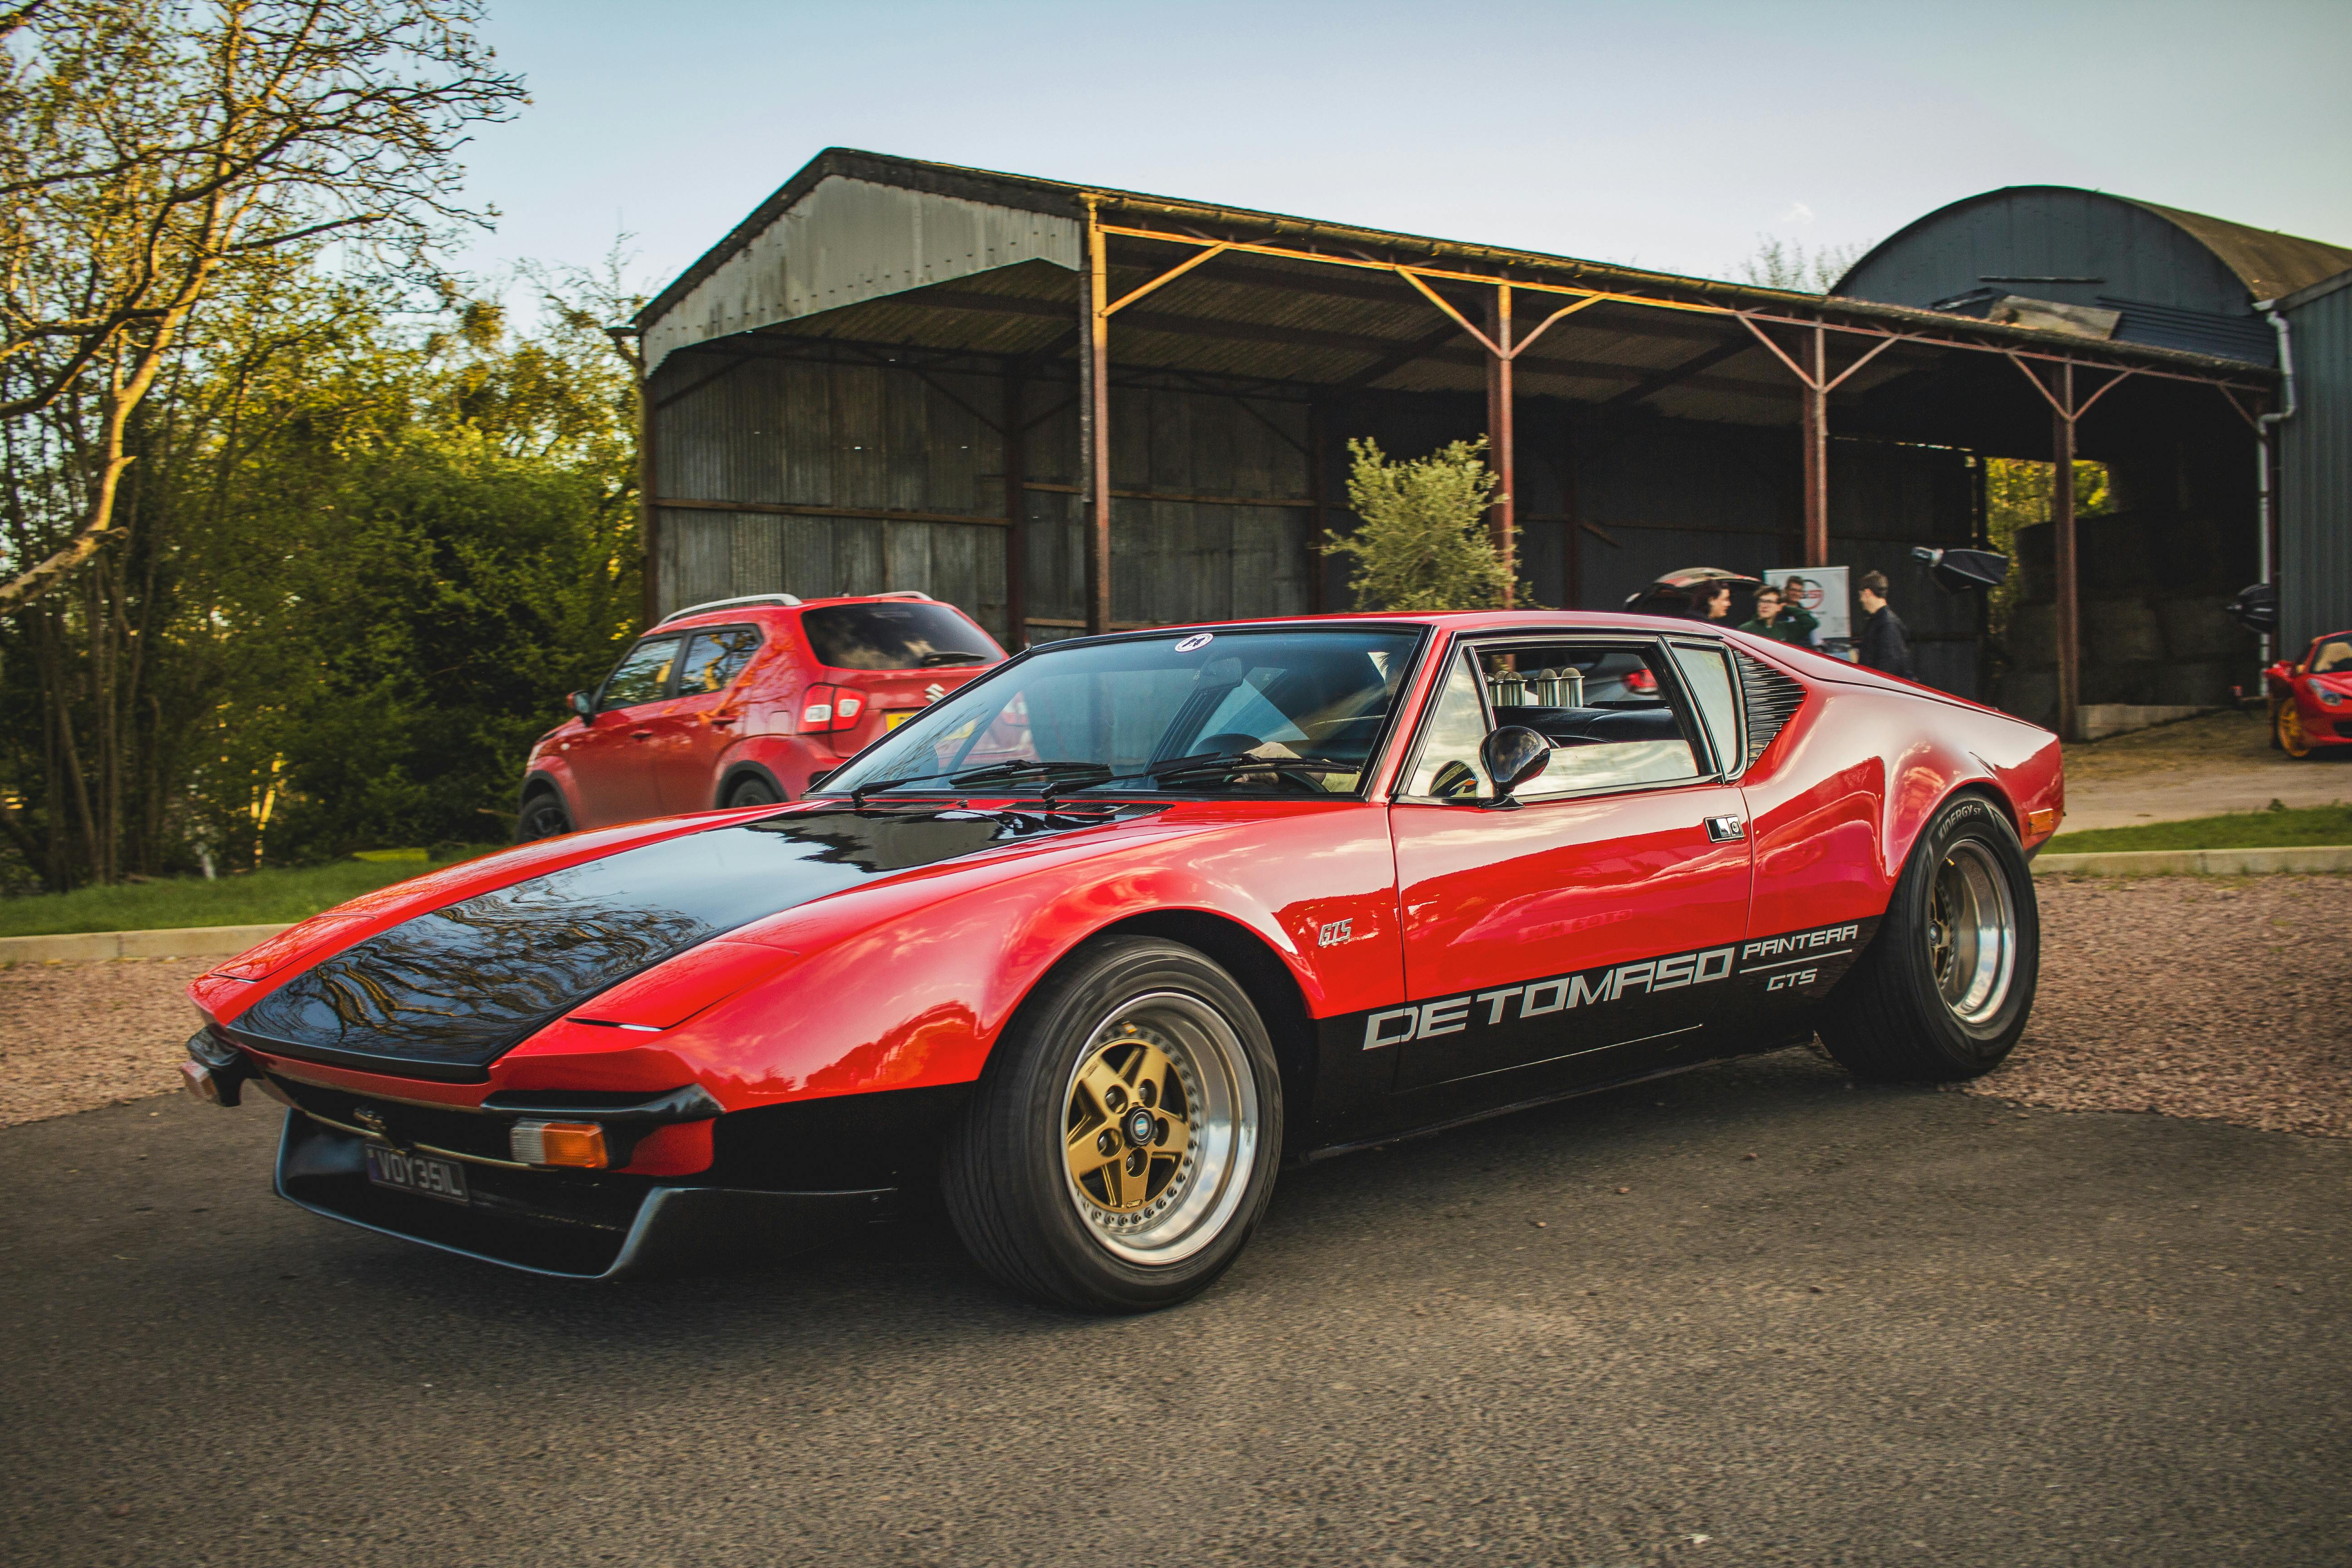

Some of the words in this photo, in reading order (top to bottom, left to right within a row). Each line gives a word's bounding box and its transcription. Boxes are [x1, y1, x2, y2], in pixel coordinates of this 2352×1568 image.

[1938, 805, 1973, 842] KINERGY
[1318, 918, 1353, 946] GTS
[1742, 925, 1858, 960] PANTERA
[1766, 968, 1818, 991] GTS
